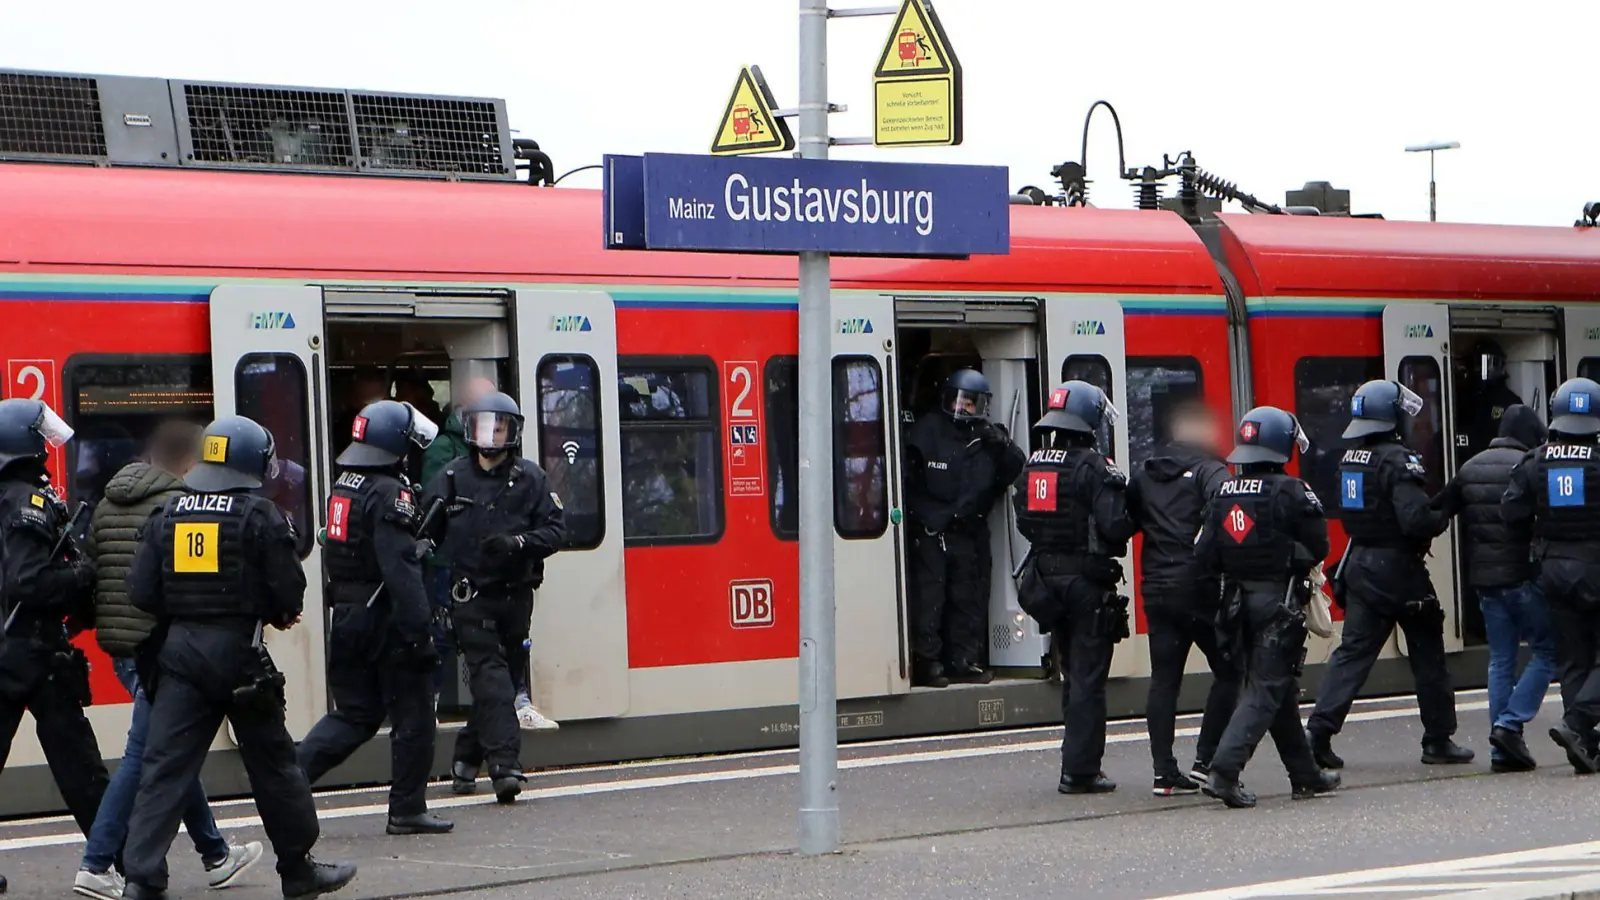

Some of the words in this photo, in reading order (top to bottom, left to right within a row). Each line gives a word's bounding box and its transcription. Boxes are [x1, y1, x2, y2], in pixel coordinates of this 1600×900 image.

[669, 197, 715, 220] Mainz
[724, 173, 933, 236] Gustavsburg
[17, 365, 45, 400] 2
[730, 366, 753, 417] 2
[1575, 397, 1583, 408] 18
[1245, 425, 1252, 437] 18
[209, 442, 218, 455] 18
[1029, 449, 1067, 463] POLIZEI
[1545, 445, 1592, 459] POLIZEI
[1035, 479, 1047, 499] 18
[1220, 480, 1262, 495] POLIZEI
[1346, 479, 1356, 499] 18
[1557, 475, 1573, 496] 18
[176, 494, 233, 512] POLIZEI
[333, 502, 343, 524] 18
[1230, 510, 1245, 531] 18
[187, 532, 204, 557] 18
[735, 587, 769, 620] DB
